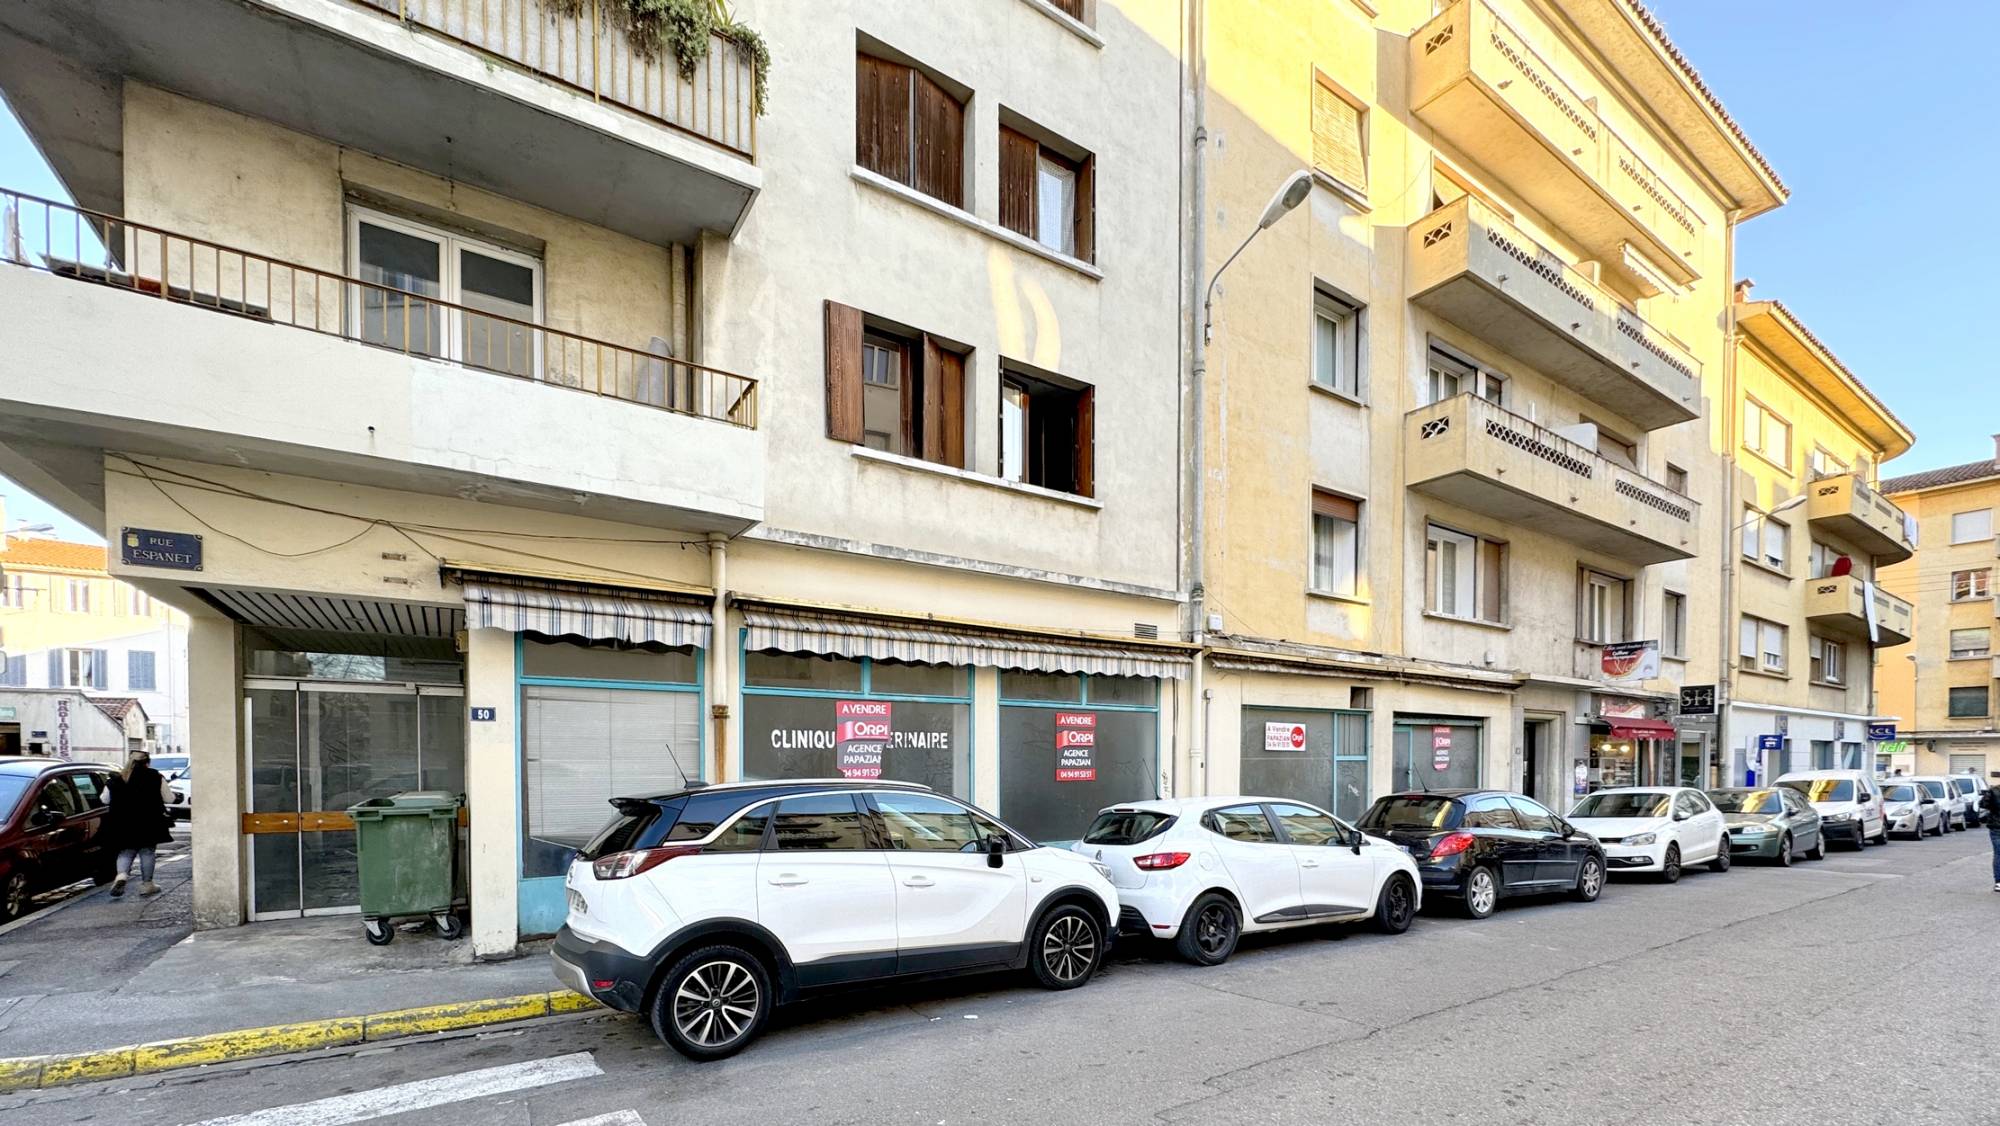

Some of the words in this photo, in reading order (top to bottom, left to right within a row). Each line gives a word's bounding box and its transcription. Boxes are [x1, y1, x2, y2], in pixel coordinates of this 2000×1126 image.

[149, 537, 173, 547] RUE
[132, 549, 192, 564] ESPANET
[478, 709, 490, 720] 50
[851, 705, 886, 715] VENDRE
[1066, 716, 1093, 725] VENDRE
[58, 700, 69, 757] RADIATEURS
[771, 729, 836, 749] CLINIQU
[886, 732, 948, 749] ERINAIRE
[847, 744, 882, 753] AGENCE
[1063, 749, 1089, 757] AGENCE
